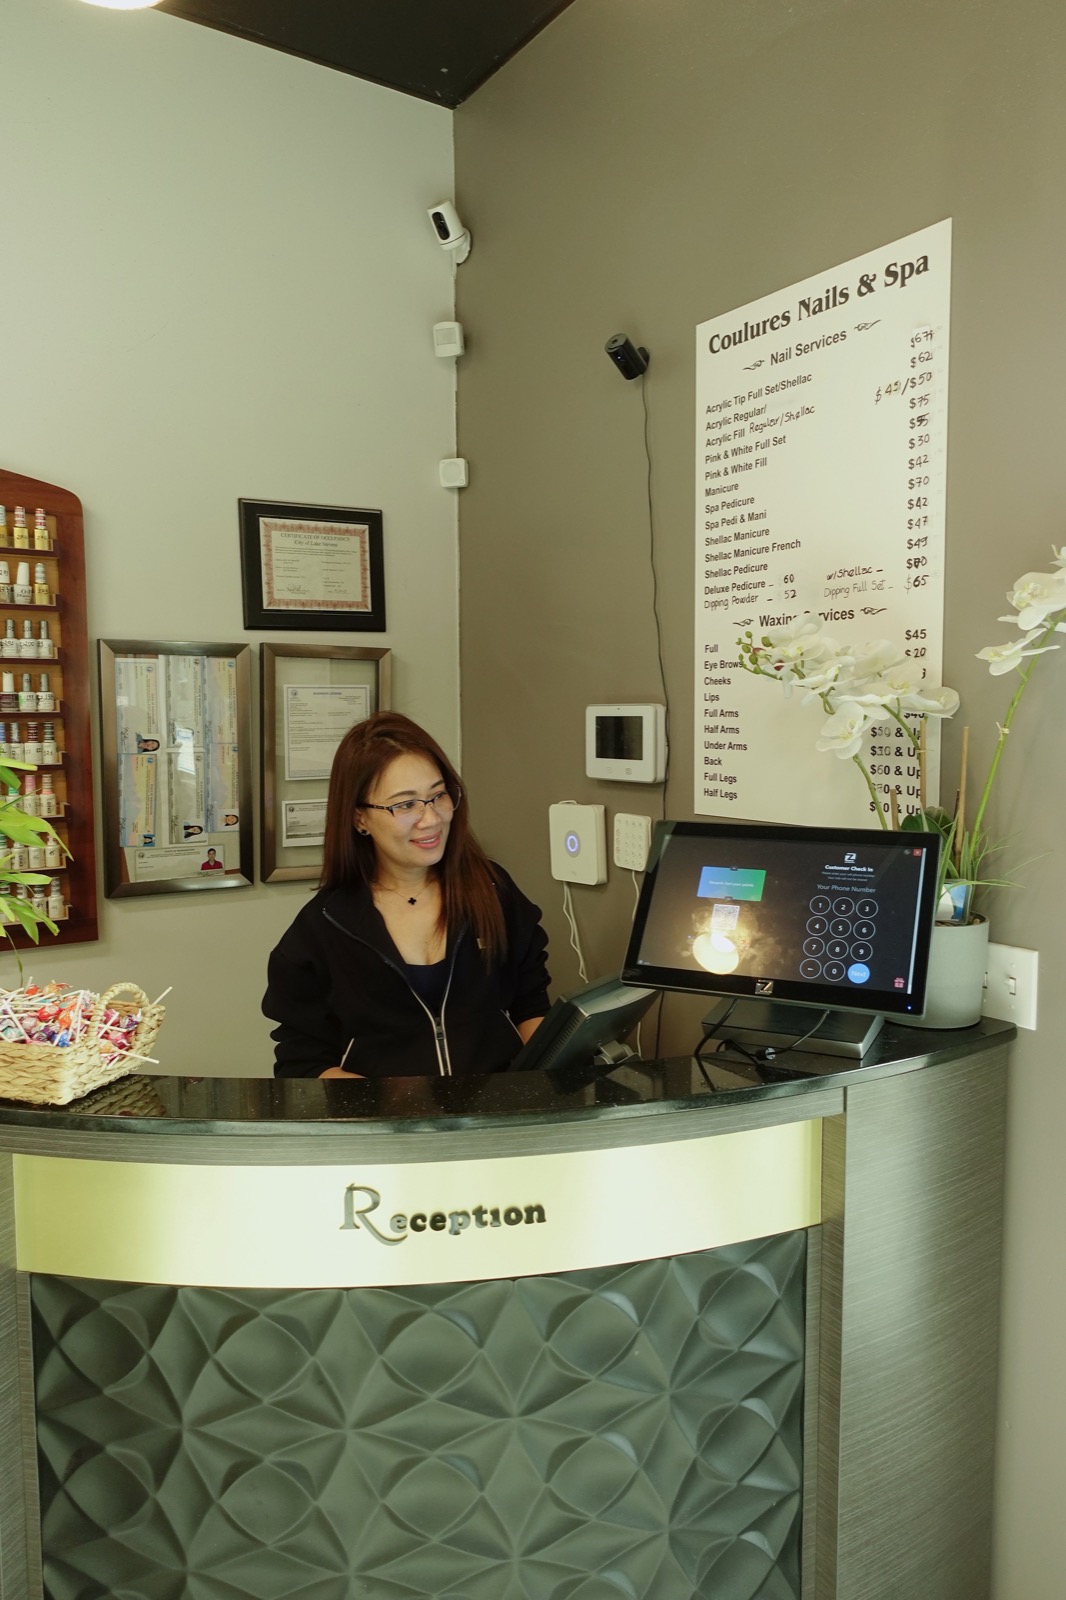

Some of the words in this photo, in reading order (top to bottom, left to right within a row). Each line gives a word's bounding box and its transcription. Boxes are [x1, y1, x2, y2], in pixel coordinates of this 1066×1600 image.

[709, 310, 790, 355] Coulures
[798, 285, 849, 321] Nails
[856, 273, 877, 298] &
[884, 254, 929, 288] Spa
[770, 347, 792, 366] Nail
[795, 330, 847, 357] Services
[706, 400, 732, 414] Acrylic
[734, 395, 746, 405] Tip
[748, 388, 762, 401] Full
[764, 374, 812, 395] Set/Shellac
[706, 417, 732, 431] Acrylic
[734, 404, 767, 422] Regular/
[705, 434, 732, 447] Acrylic
[733, 428, 745, 440] Fill
[705, 453, 721, 464] Pink
[723, 450, 729, 459] &
[731, 445, 752, 457] White
[755, 439, 770, 451] Full
[772, 435, 786, 446] Set
[705, 470, 721, 481] Pink
[723, 467, 729, 476] &
[731, 462, 752, 474] White
[755, 457, 767, 468] Fill
[705, 483, 739, 497] Manicure
[705, 504, 719, 514] Spa
[721, 497, 755, 510] Pedicure
[705, 521, 719, 531] Spa
[721, 516, 737, 527] Pedi
[740, 514, 745, 523] &
[748, 510, 766, 521] Mani
[705, 535, 732, 546] Shellac
[734, 528, 770, 541] Manicure
[705, 552, 732, 562] Shellac
[734, 545, 769, 558] Manicure
[772, 539, 801, 552] French
[705, 568, 732, 579] Shellac
[734, 563, 768, 575] Pedicure
[783, 574, 794, 584] 60
[853, 581, 867, 593] Full
[871, 579, 886, 591] Set
[705, 585, 729, 595] Deluxe
[732, 580, 765, 592] Pedicure
[732, 593, 759, 605] Powder
[784, 590, 797, 599] 52
[759, 613, 799, 627] Waxin
[803, 608, 855, 622] vices
[905, 629, 927, 640] $45
[705, 644, 718, 653] Full
[704, 661, 718, 671] Eye
[720, 660, 743, 668] Brows
[704, 677, 731, 685] Cheeks
[704, 693, 720, 703] Lips
[704, 709, 718, 717] Full
[719, 709, 739, 717] Arms
[704, 725, 719, 733] Half
[720, 725, 739, 734] Arms
[895, 727, 904, 737] &
[704, 741, 726, 749] Under
[727, 742, 747, 750] Arms
[894, 747, 903, 757] &
[704, 757, 722, 765] Back
[870, 765, 890, 775] $60
[894, 766, 903, 776] &
[704, 772, 717, 781] Full
[719, 774, 737, 784] Legs
[704, 788, 718, 797] Half
[720, 789, 737, 800] Legs
[339, 1182, 547, 1246] Reception
